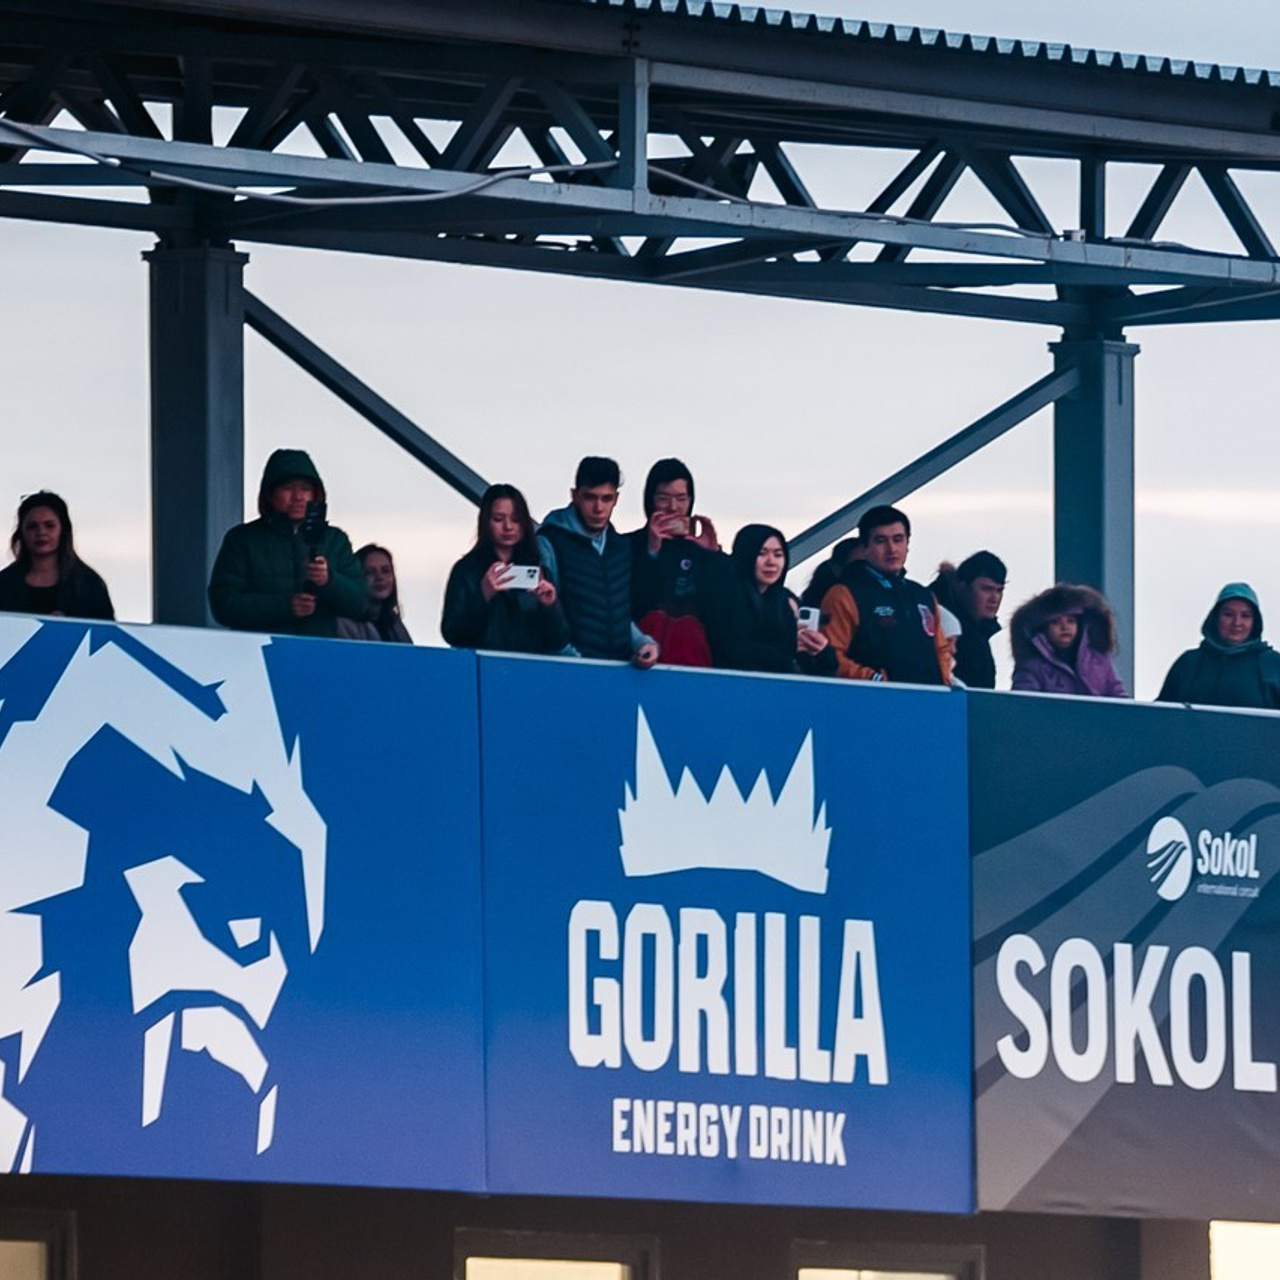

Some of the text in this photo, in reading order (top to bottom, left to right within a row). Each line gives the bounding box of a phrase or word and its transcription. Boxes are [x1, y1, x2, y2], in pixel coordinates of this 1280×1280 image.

[567, 899, 890, 1086] GORILLA
[611, 1097, 847, 1167] ENERGY DRINK
